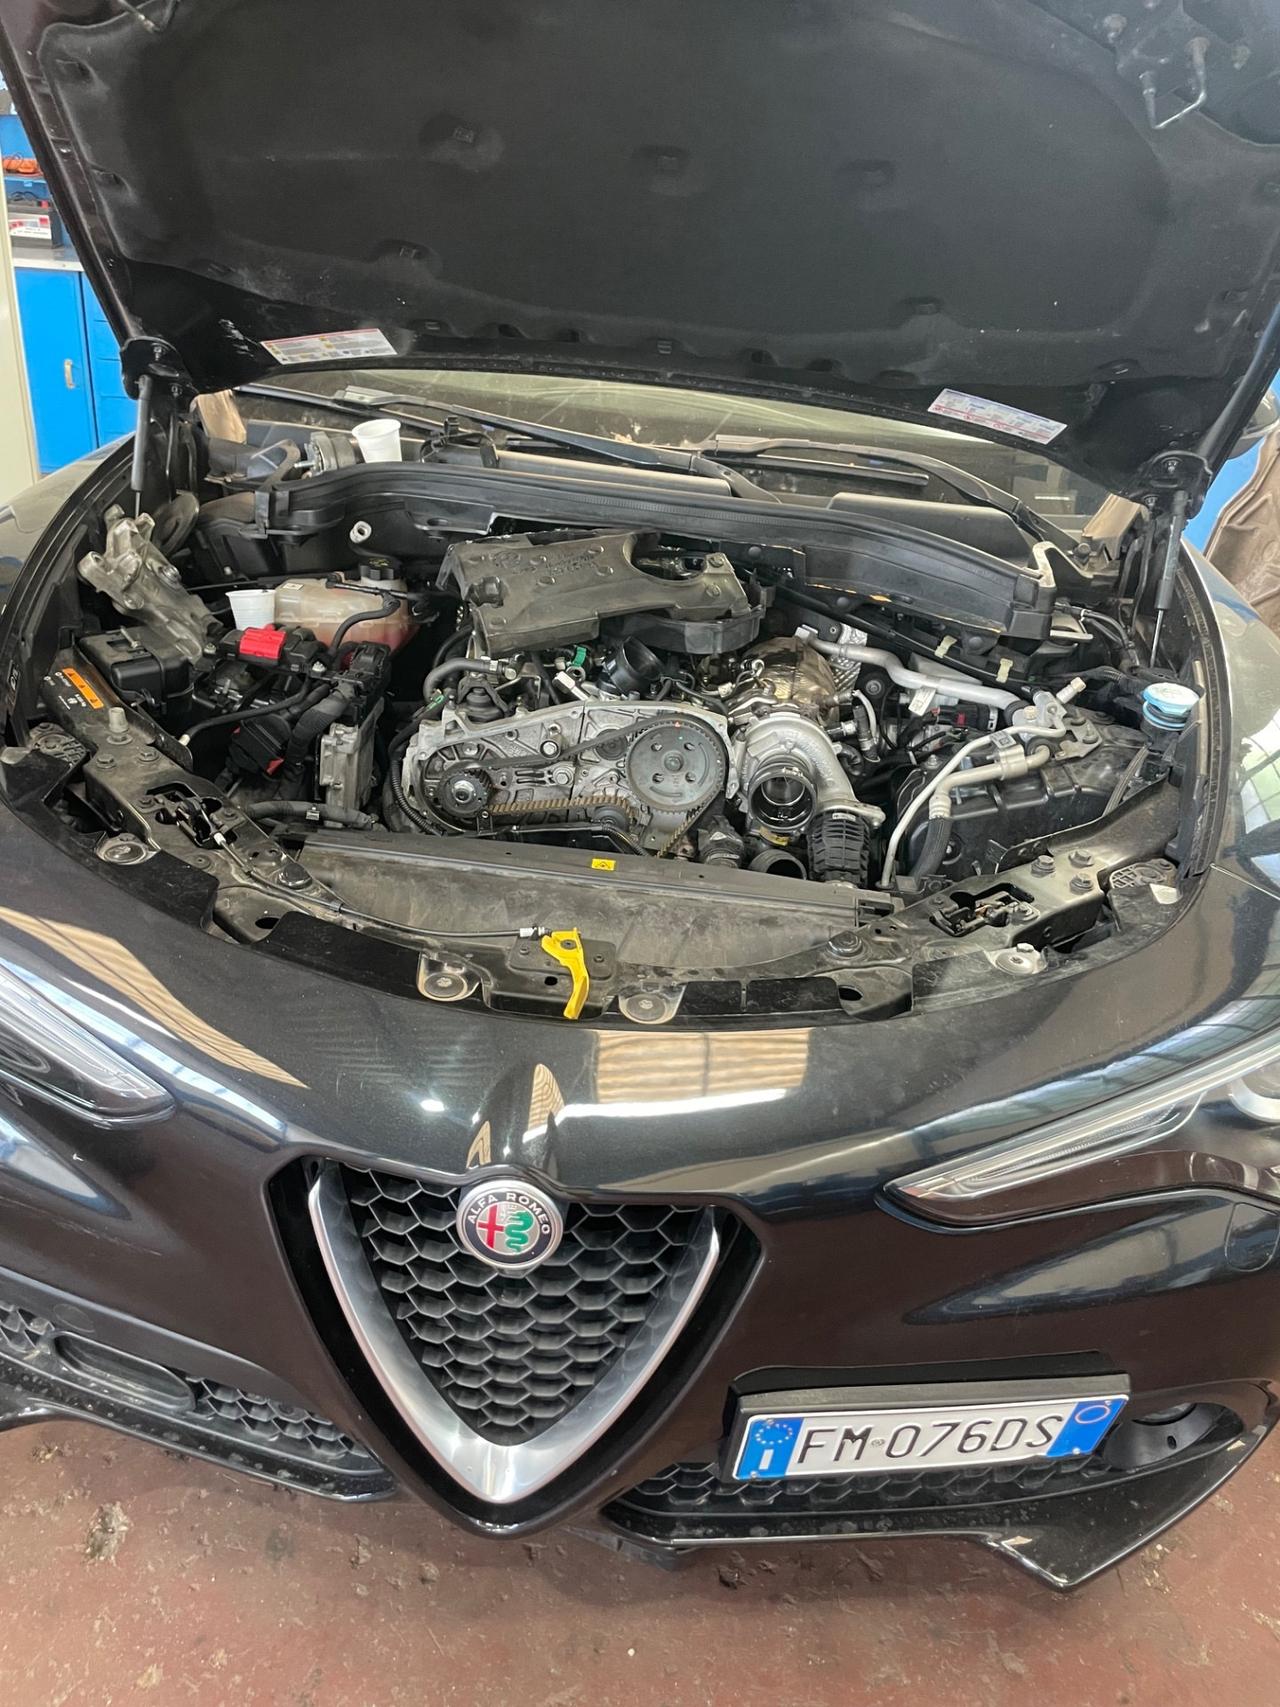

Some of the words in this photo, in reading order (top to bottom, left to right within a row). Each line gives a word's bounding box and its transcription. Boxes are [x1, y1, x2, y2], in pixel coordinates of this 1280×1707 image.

[467, 1194, 499, 1224] ALFA
[506, 1192, 551, 1235] ROMEO
[797, 1423, 873, 1465] FM
